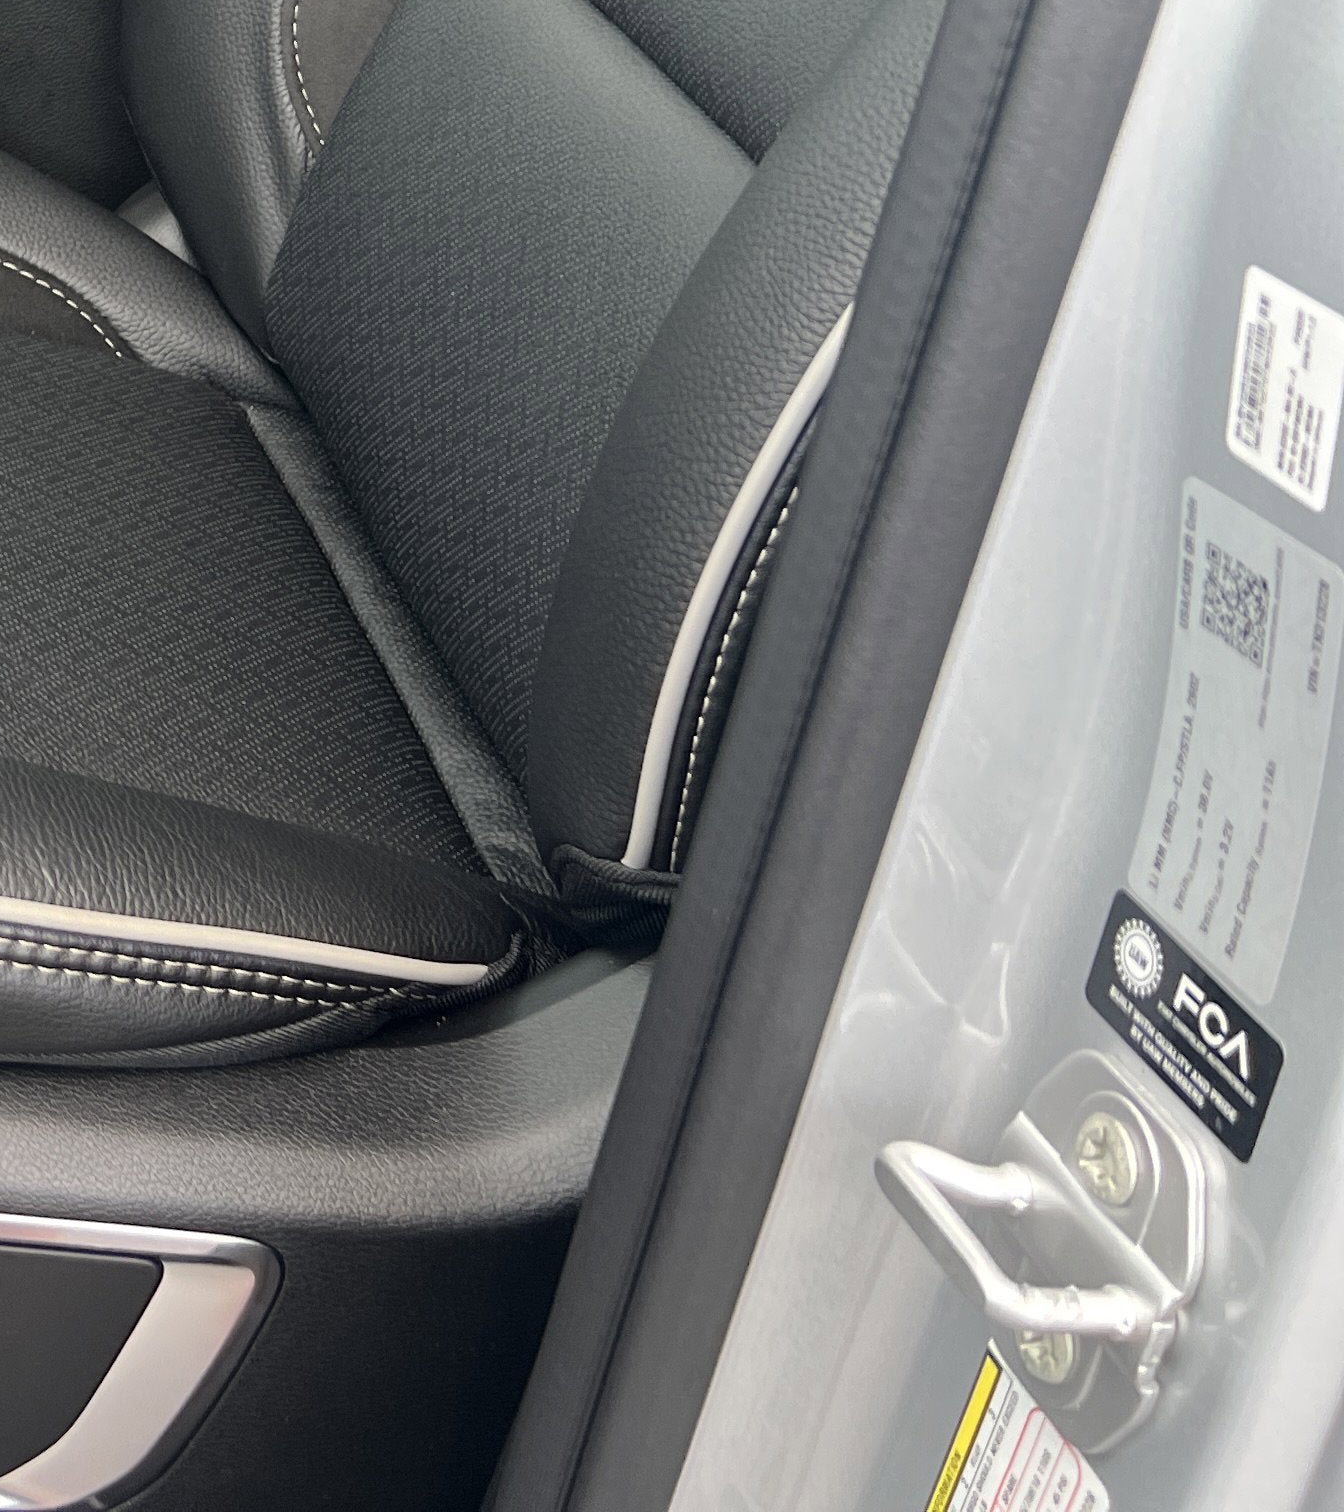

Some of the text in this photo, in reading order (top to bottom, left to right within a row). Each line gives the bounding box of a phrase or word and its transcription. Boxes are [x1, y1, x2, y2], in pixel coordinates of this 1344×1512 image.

[1110, 984, 1133, 1016] BUILT
[1132, 1008, 1155, 1037] WITH
[1155, 1031, 1192, 1073] QUALITY
[1190, 1069, 1211, 1094] AND
[1130, 1023, 1143, 1044] BY
[1162, 1057, 1205, 1109] MEMBERS
[1173, 973, 1249, 1079] FCA
